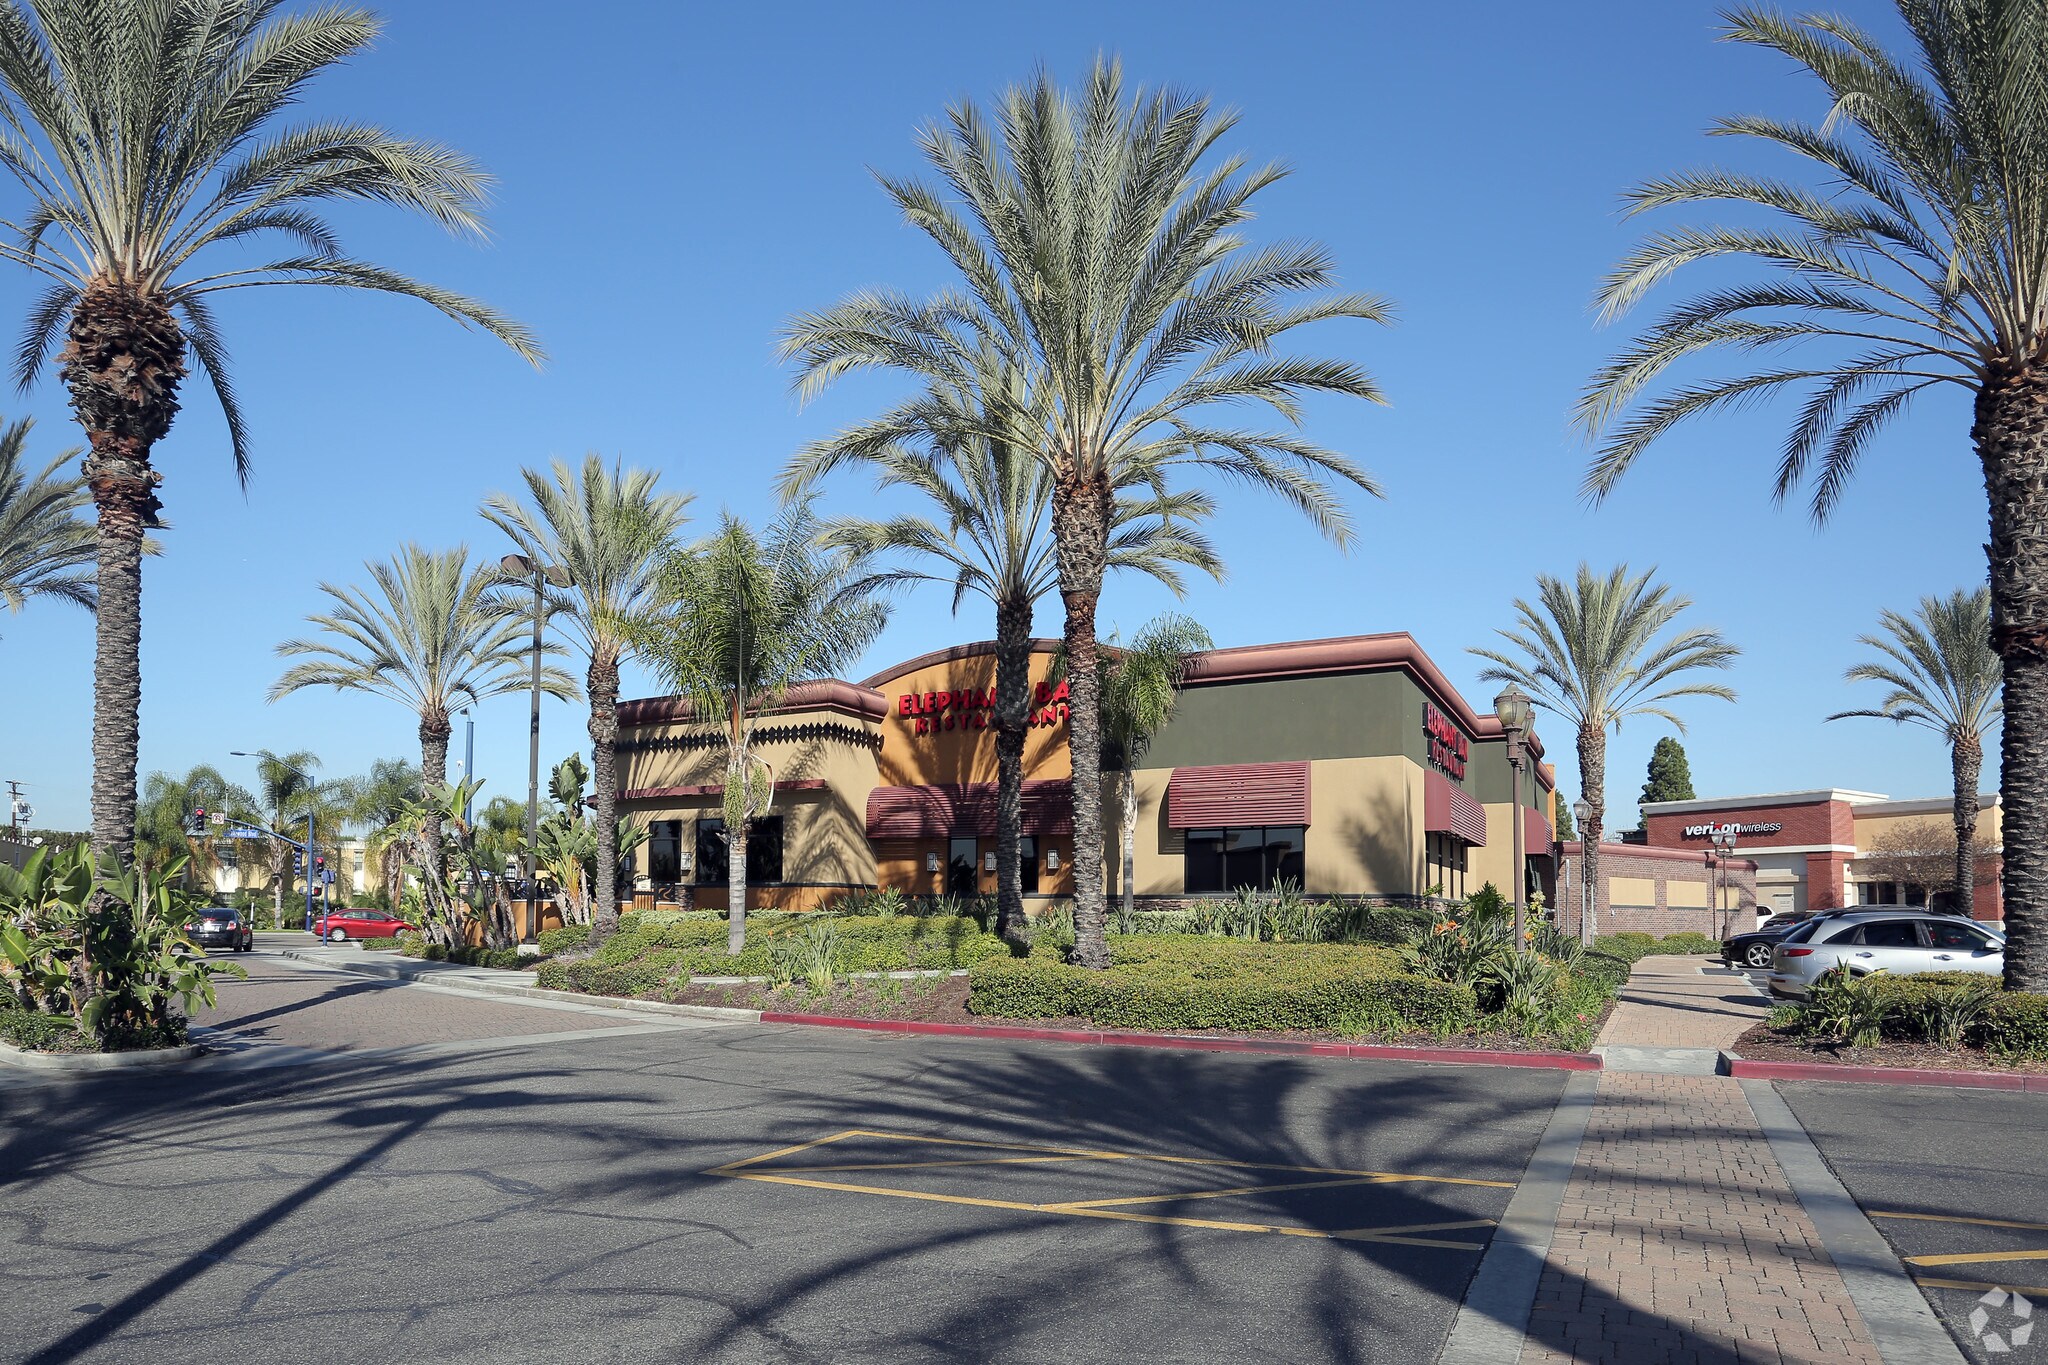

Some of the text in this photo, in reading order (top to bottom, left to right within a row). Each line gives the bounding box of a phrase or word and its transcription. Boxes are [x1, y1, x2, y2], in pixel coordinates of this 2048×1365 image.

[898, 680, 1071, 717] ELEPHA BA
[915, 704, 1071, 735] RESTAANT
[1740, 821, 1782, 834] wireless
